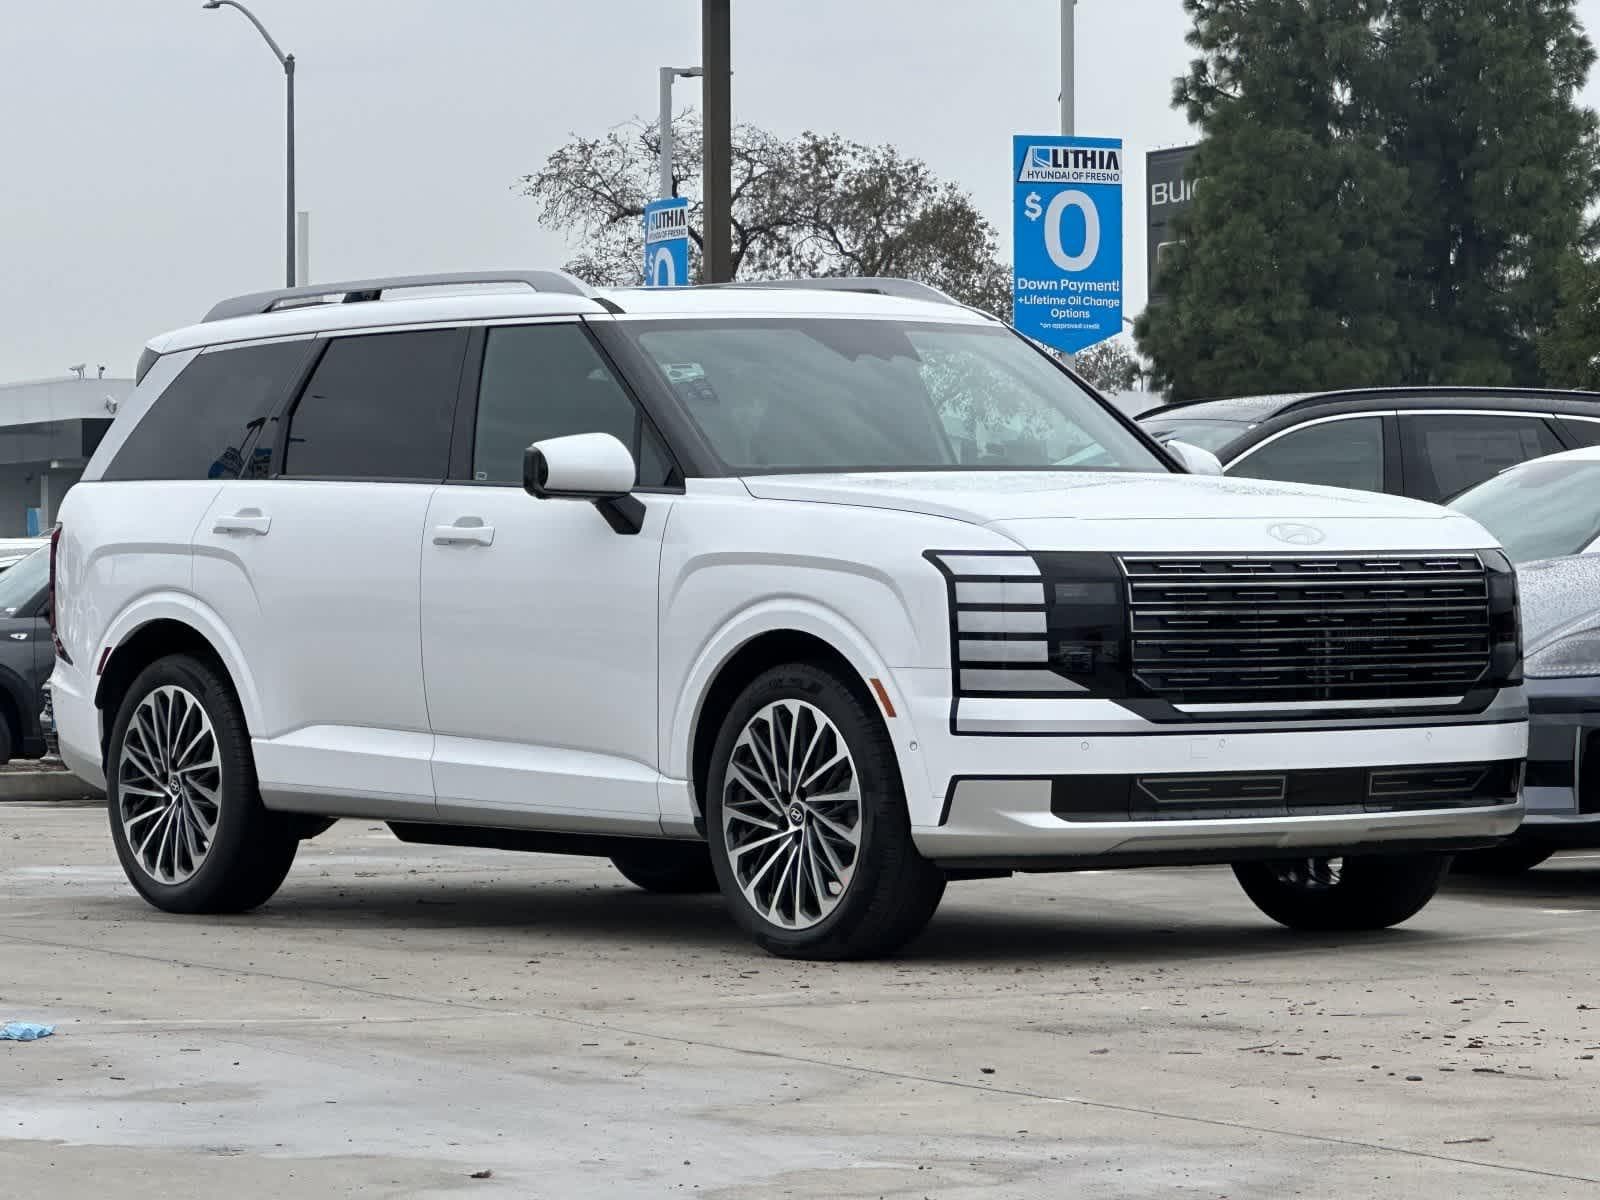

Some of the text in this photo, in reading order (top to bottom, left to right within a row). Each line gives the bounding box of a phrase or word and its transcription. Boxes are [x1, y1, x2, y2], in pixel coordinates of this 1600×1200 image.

[1051, 149, 1119, 170] LITHIA
[1027, 171, 1120, 182] HYUNDAI OF FRESNO
[656, 209, 686, 229] LITHIA
[1018, 278, 1120, 293] Down Payment!
[1018, 295, 1120, 308] +Lifetime Oil Change
[1050, 308, 1090, 319] Options
